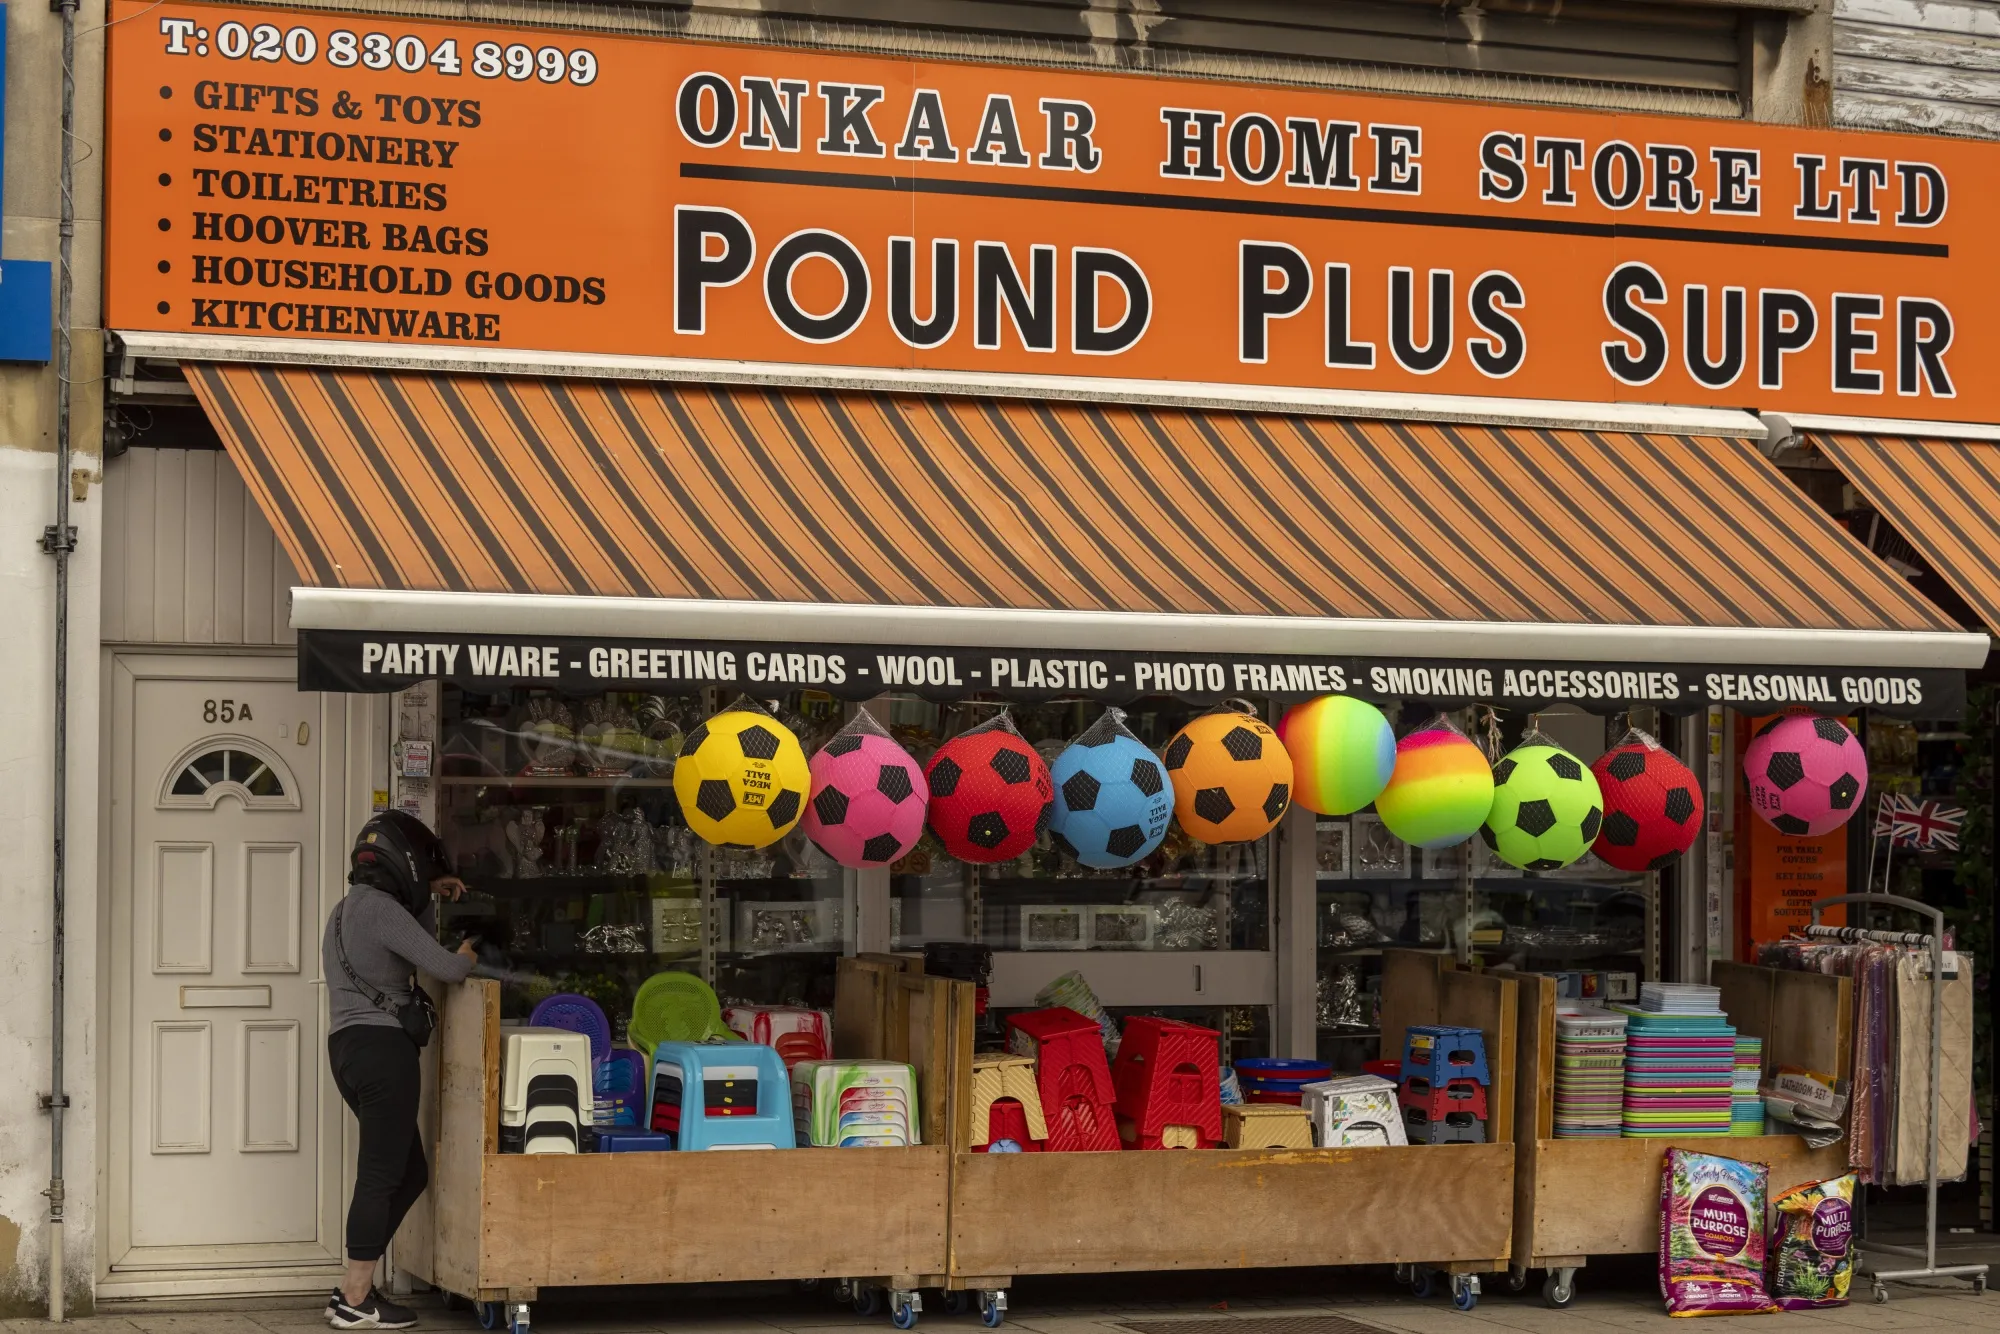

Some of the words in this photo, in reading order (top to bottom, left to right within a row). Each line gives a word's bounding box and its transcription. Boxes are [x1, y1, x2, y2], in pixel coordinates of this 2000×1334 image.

[326, 29, 462, 76] 8304
[472, 41, 599, 86] 8999
[194, 80, 319, 117] GIFTS
[332, 90, 362, 120] &
[375, 93, 482, 129] TOYS
[193, 123, 460, 169] STATIONERY
[675, 71, 1103, 174] ONKAAR
[1159, 106, 1423, 196] HOME
[1479, 130, 1761, 217] STORE
[1793, 152, 1949, 228] LTD
[192, 168, 448, 212] TOILETRIES
[192, 211, 371, 250] HOOVER
[382, 222, 489, 257] BAGS
[191, 254, 452, 297] HOUSEHOLD
[464, 270, 606, 306] GOODS
[673, 203, 1153, 356] POUND
[1238, 239, 1527, 379] PLUS
[1600, 260, 1957, 399] SUPER
[191, 298, 500, 342] KITCHENWARE
[363, 643, 459, 674] PARTY
[468, 645, 560, 676] WARE
[590, 648, 737, 681] GREETING
[747, 652, 847, 684] CARDS
[877, 656, 963, 686] WOOL
[991, 658, 1108, 689] PLASTIC
[1134, 662, 1225, 691] PHOTO
[1233, 663, 1347, 692] FRAMES
[1371, 667, 1493, 696] SMOKING
[1503, 670, 1680, 700] ACCESSORIES
[1706, 673, 1836, 702] SEASONAL
[1842, 676, 1922, 705] GOODS
[203, 699, 253, 723] 85A
[742, 778, 771, 790] MEGA
[745, 769, 771, 780] BALL
[1148, 811, 1167, 825] MEGA
[1150, 804, 1167, 816] BALL
[1776, 872, 1794, 880] KEY
[1796, 872, 1823, 880] RINGS
[1781, 889, 1817, 897] LONDON
[1774, 908, 1825, 916] SOUVENS
[1786, 899, 1812, 907] GIFTS
[1781, 1078, 1813, 1097] BATHROOM
[1693, 1167, 1720, 1185] Simply
[1703, 1207, 1737, 1224] MULTI
[1821, 1210, 1847, 1226] MULTI
[1693, 1217, 1747, 1238] PURPOSE
[1704, 1231, 1735, 1243] COMPOST
